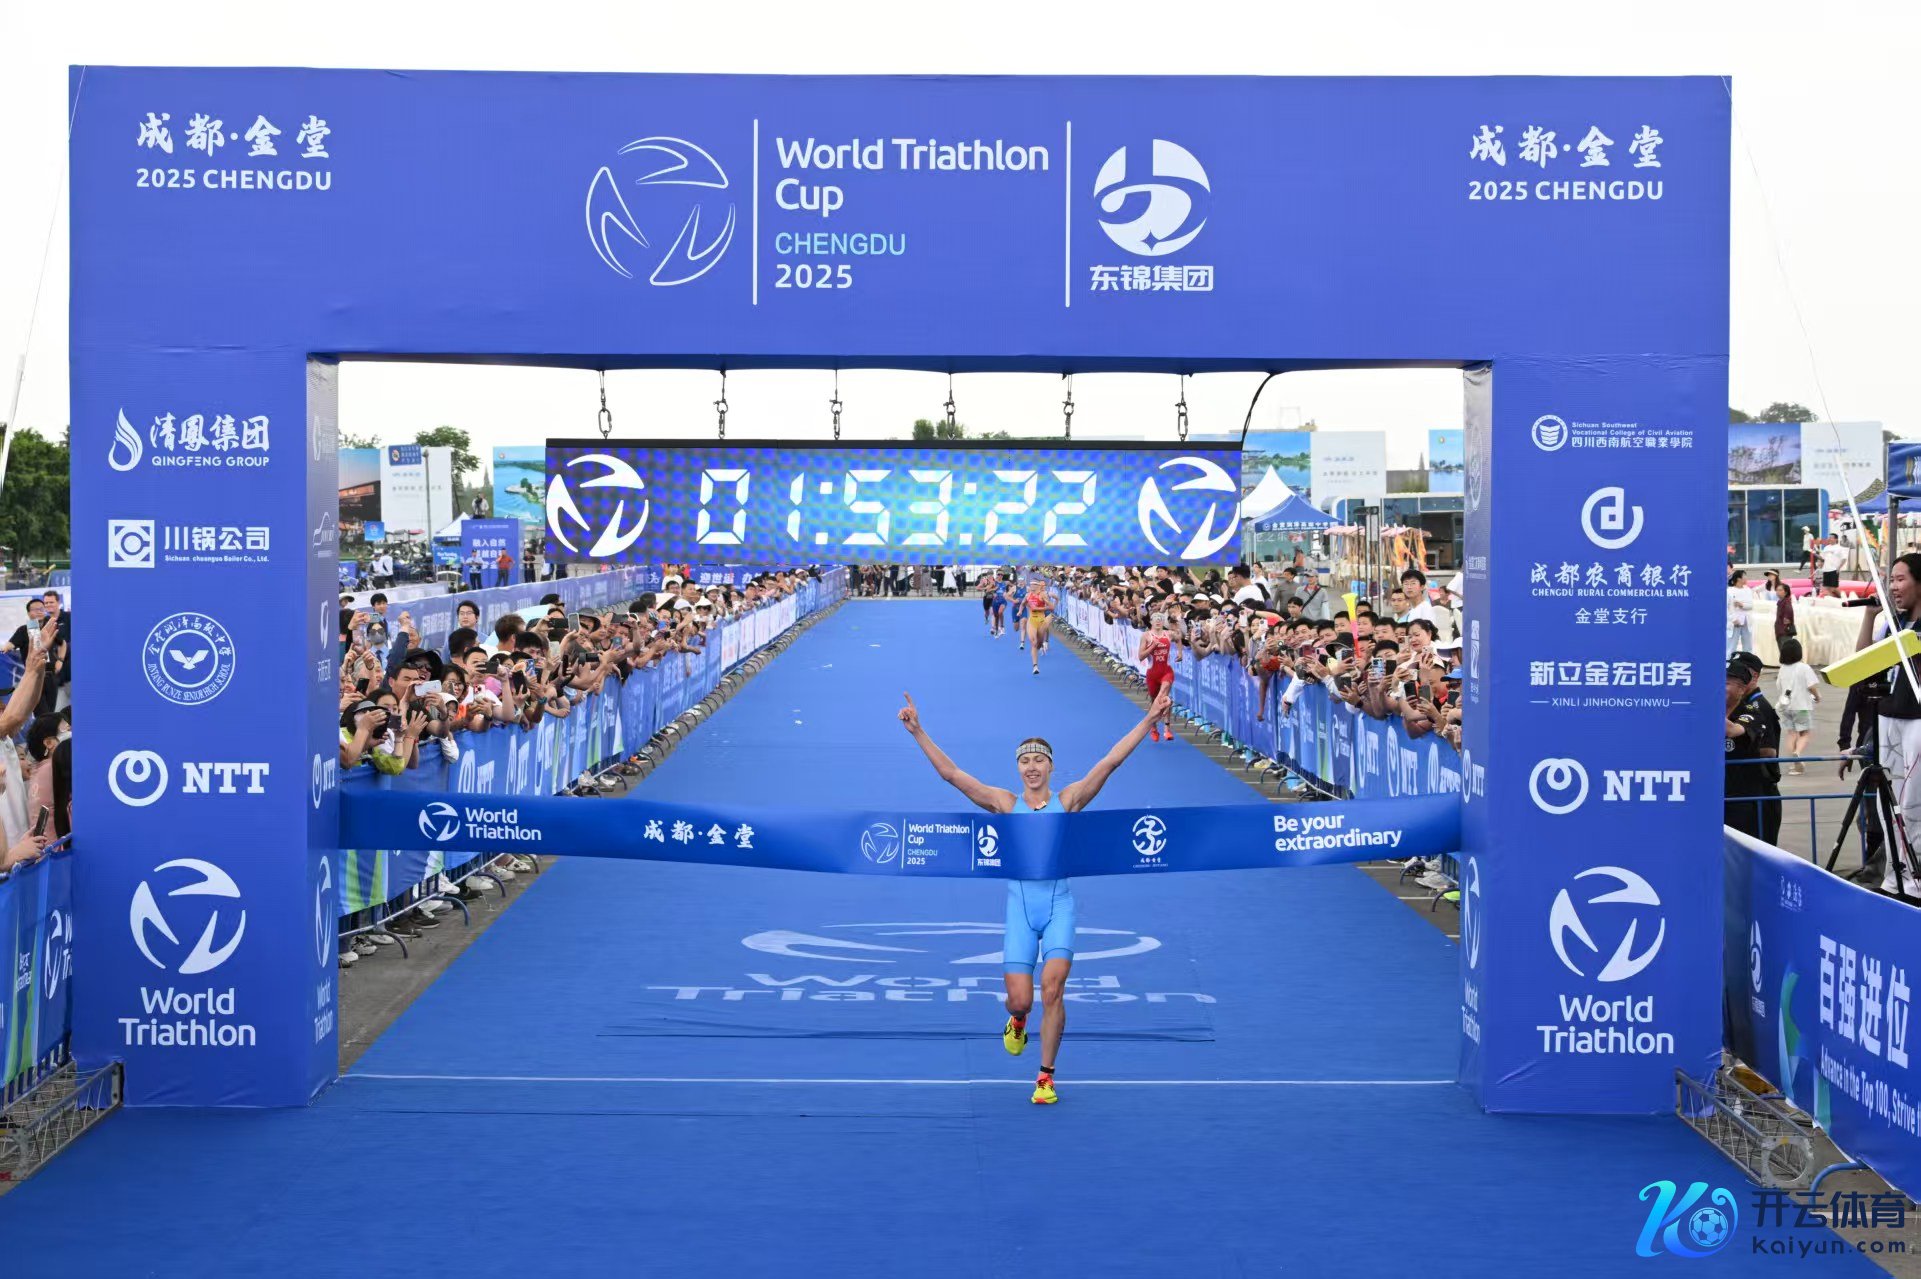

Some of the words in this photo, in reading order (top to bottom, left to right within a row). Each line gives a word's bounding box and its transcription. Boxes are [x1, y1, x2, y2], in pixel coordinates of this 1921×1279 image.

[137, 113, 330, 158] 成都·金堂
[1470, 125, 1663, 168] 成都·金堂
[776, 138, 883, 169] World
[892, 139, 1048, 170] Triathlon
[137, 168, 195, 188] 2025
[203, 170, 331, 190] CHENGDU
[1469, 181, 1527, 200] 2025
[1536, 181, 1662, 200] CHENGDU
[776, 178, 843, 217] Cup
[776, 233, 905, 255] CHENGDU
[776, 264, 852, 288] 2025
[1090, 265, 1213, 291] 东锦集团
[1609, 429, 1635, 437] College
[152, 456, 221, 467] QINGFENG
[226, 456, 269, 467] GROUP
[695, 468, 1097, 546] 01:53:22
[165, 527, 269, 550] 川锅公司
[1530, 562, 1692, 588] 成都农商银行
[1532, 588, 1574, 597] CHENGDU
[1578, 588, 1605, 597] RURAL
[1607, 589, 1665, 597] COMMERCIAL
[1667, 589, 1690, 597] BANK
[1575, 607, 1648, 625] 金堂支行
[1531, 661, 1691, 686] 新立金宏印务
[1552, 698, 1580, 707] XINLI
[1583, 698, 1670, 708] JINHONGYINWU
[183, 763, 269, 793] NTT
[1604, 770, 1690, 801] NTT
[466, 807, 517, 824] World
[1274, 814, 1298, 832] Be
[1300, 814, 1344, 836] your
[466, 823, 542, 841] Triathlon
[643, 819, 755, 849] 成都·金堂
[908, 824, 934, 834] World
[936, 823, 970, 834] Triathlon
[908, 834, 925, 846] Cup
[1275, 829, 1402, 852] extraordinary
[906, 857, 926, 865] 2025
[744, 973, 1120, 988] Word
[141, 987, 234, 1014] World
[1560, 995, 1653, 1022] World
[1819, 933, 1911, 1069] 百强进位
[119, 1018, 255, 1046] Triathlon
[1537, 1026, 1673, 1053] Triathlon
[1861, 1071, 1874, 1119] Top
[1875, 1079, 1890, 1129] 100,
[1892, 1088, 1916, 1135] Strive
